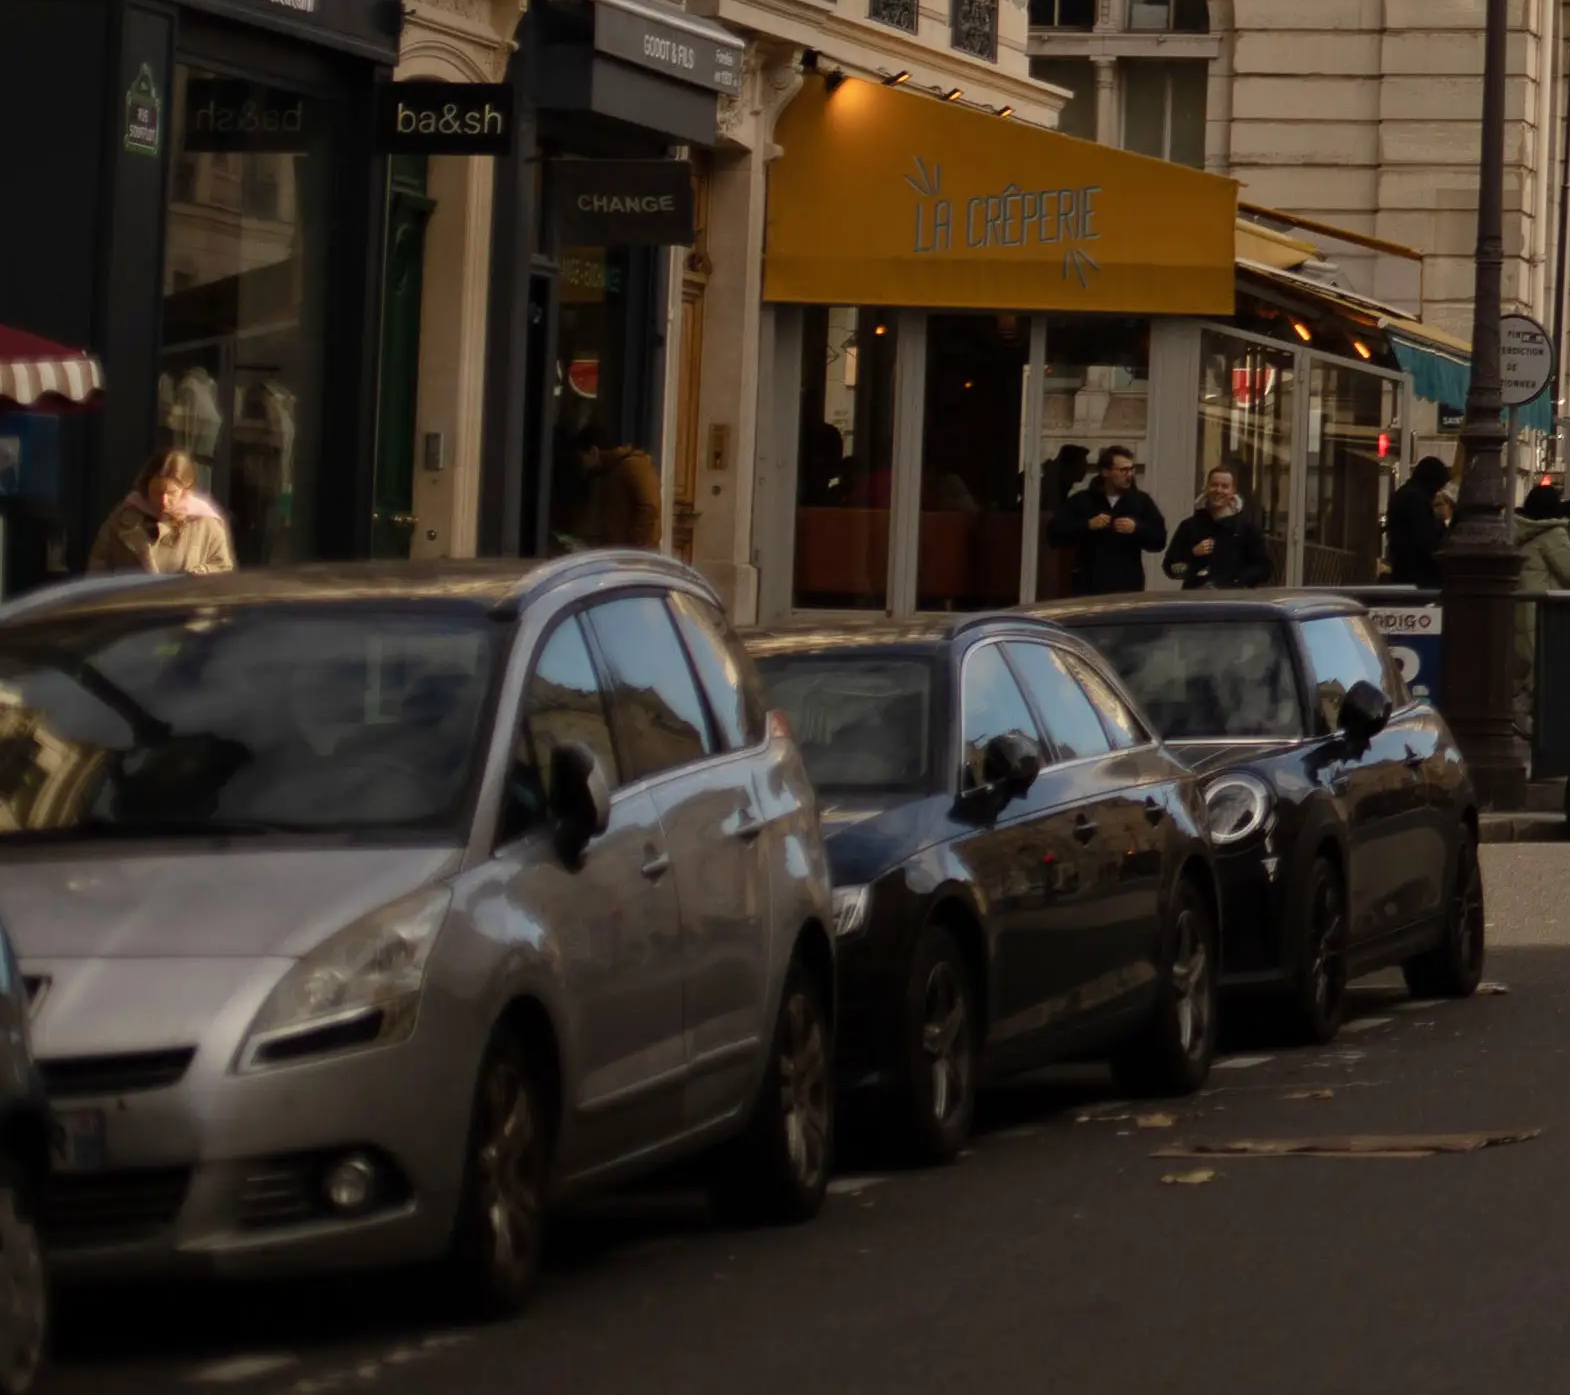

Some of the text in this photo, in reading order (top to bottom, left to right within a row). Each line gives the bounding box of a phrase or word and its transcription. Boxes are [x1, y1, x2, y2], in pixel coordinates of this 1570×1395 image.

[397, 101, 503, 135] ba&sh
[577, 194, 676, 213] CHANGE
[914, 183, 1103, 253] LA CRÊPERIE
